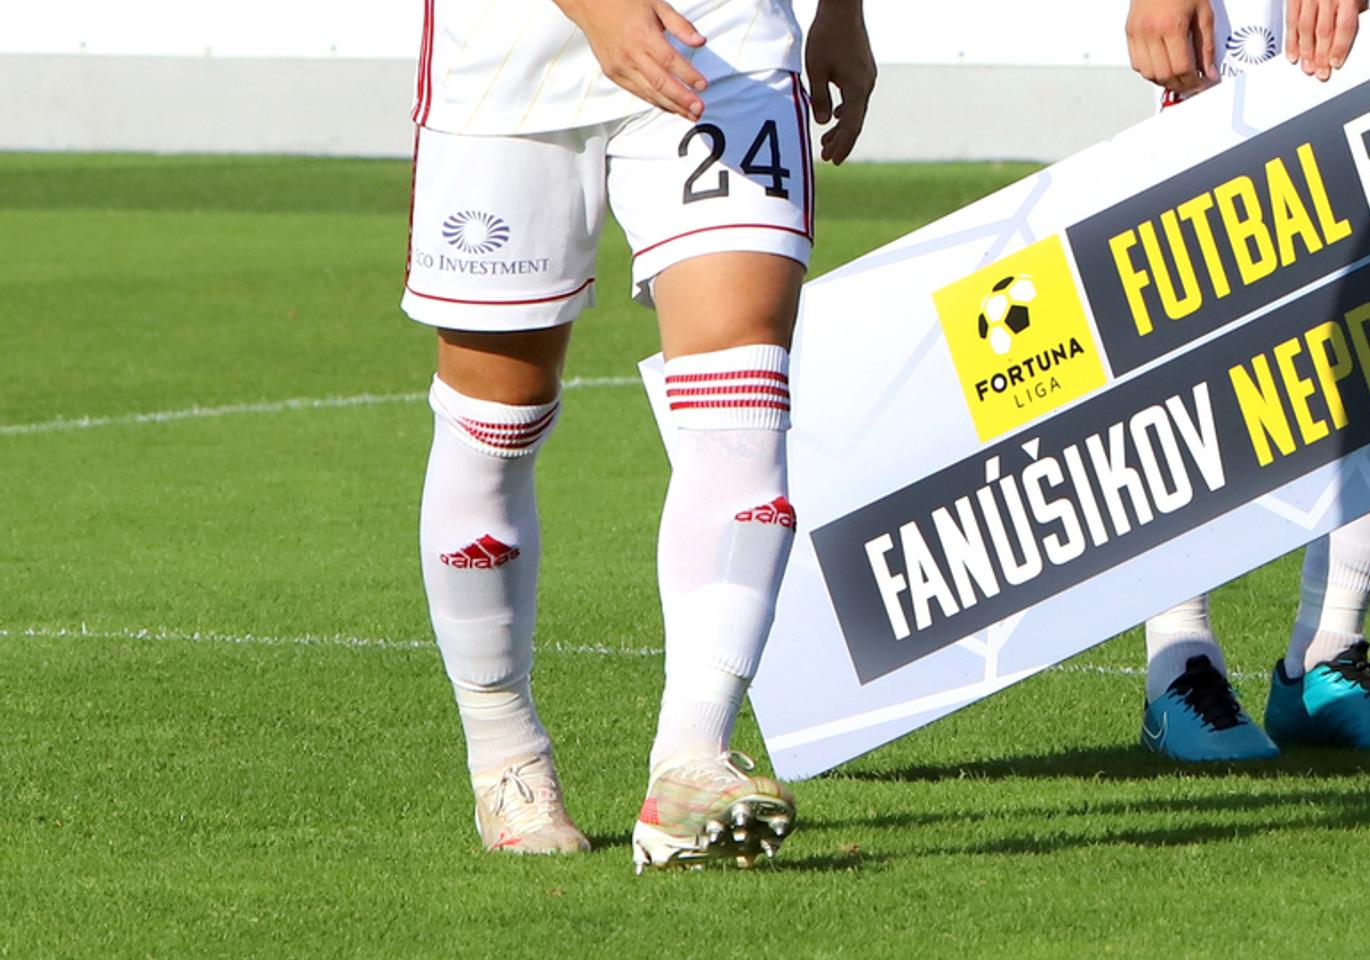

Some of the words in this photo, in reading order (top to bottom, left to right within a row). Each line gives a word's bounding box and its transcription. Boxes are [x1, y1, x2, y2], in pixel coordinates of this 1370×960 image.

[678, 120, 790, 205] 24
[439, 255, 550, 275] INVESTMENT
[1108, 143, 1352, 336] FUTBAL
[975, 337, 1085, 402] FORTUNA
[1014, 376, 1061, 408] LIGA
[864, 381, 1225, 641] FANÚŠIKOV
[440, 547, 521, 569] adidas
